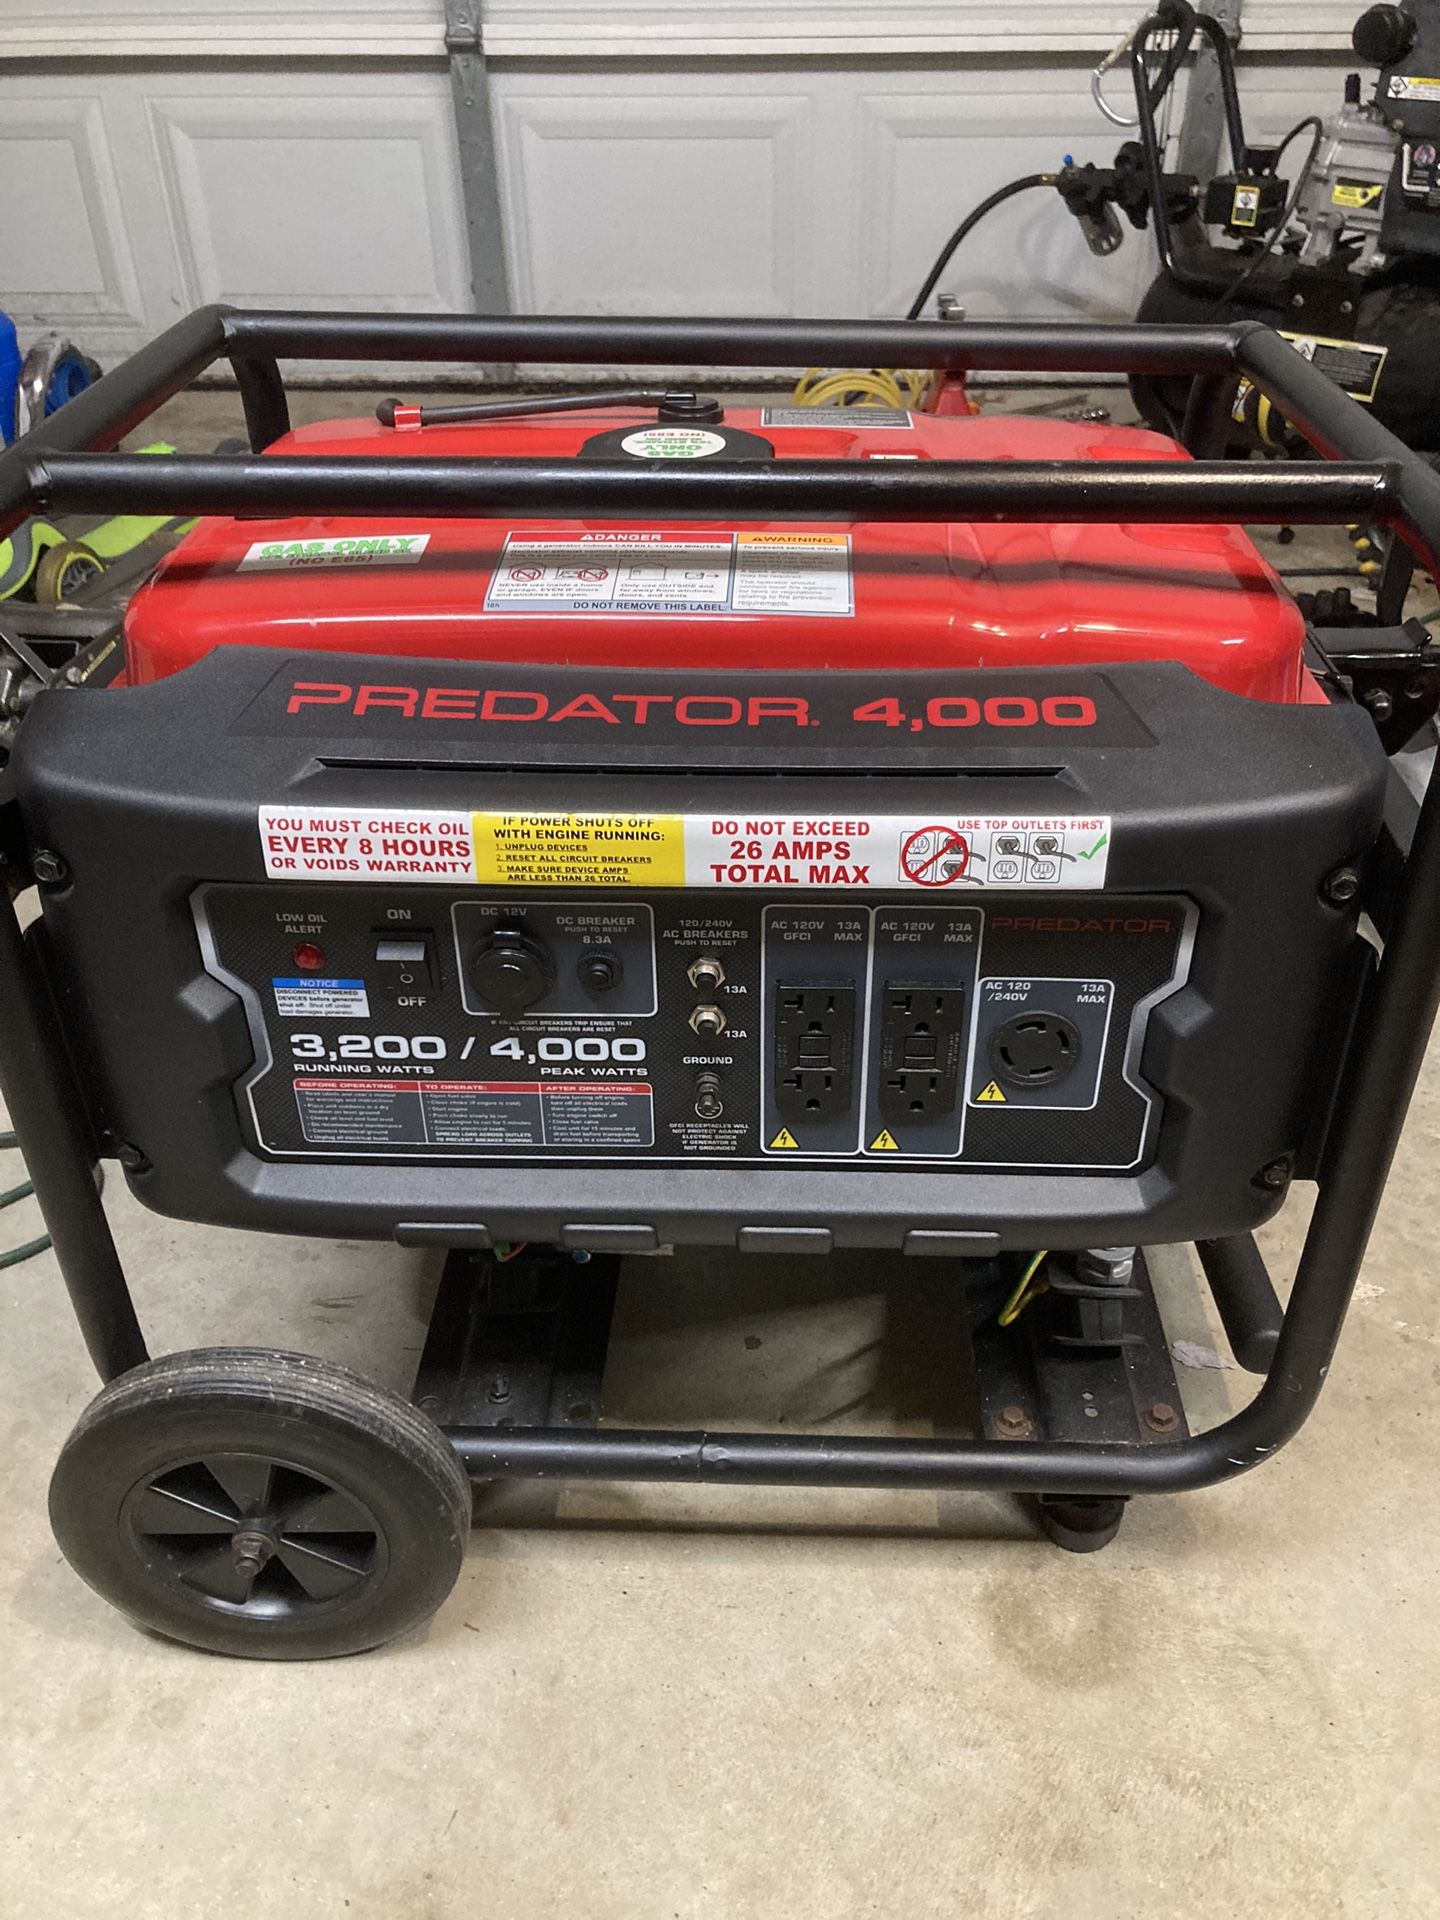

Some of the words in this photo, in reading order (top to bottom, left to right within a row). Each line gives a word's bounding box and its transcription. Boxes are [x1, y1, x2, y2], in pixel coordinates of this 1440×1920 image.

[592, 534, 661, 542] DANGER
[261, 542, 325, 557] GAS
[333, 537, 418, 554] ONLY
[289, 557, 325, 567] (NO
[331, 555, 373, 565] E85)
[616, 602, 660, 610] REMOVE
[690, 603, 727, 611] LABEL.
[853, 695, 1097, 731] 4,000
[266, 818, 303, 831] YOU
[309, 820, 362, 833] MUST
[368, 821, 431, 834] CHECK
[438, 823, 469, 835] OIL
[503, 816, 515, 826] IF
[521, 816, 570, 827] POWER
[575, 818, 623, 828] SHUTS
[628, 818, 655, 828] OFF
[957, 820, 980, 830] USE
[984, 820, 1008, 830] TOP
[1012, 820, 1067, 830] OUTLETS
[1070, 820, 1104, 830] FIRST
[712, 821, 738, 835] DO
[746, 821, 786, 835] NOT
[793, 821, 870, 836] EXCEED
[494, 829, 531, 839] WITH
[536, 830, 590, 840] ENGINE
[595, 831, 665, 841] RUNNING:
[267, 836, 348, 854] EVERY
[359, 838, 373, 855] 8
[383, 839, 471, 857] HOURS
[730, 841, 763, 860] 26
[771, 841, 851, 860] AMPS
[560, 855, 599, 863] CIRCUIT
[271, 857, 297, 869] OR
[304, 858, 360, 870] VOIDS
[367, 860, 471, 873] WARRANTY
[599, 875, 631, 883] TOTAL.
[710, 865, 799, 883] TOTAL
[809, 865, 870, 884] MAX
[387, 909, 412, 920] ON
[481, 907, 498, 916] DC
[503, 907, 527, 916] 12V
[276, 913, 304, 922] LOW
[307, 914, 328, 923] OIL
[556, 917, 574, 925] DC
[578, 917, 635, 926] BREAKER
[680, 920, 733, 928] 120/240V
[771, 921, 787, 929] AC
[792, 921, 825, 930] 120V
[837, 921, 861, 930] 13A
[881, 922, 898, 930] AC
[902, 922, 936, 931] 120V
[947, 923, 972, 931] 13A
[285, 925, 323, 934] ALERT
[663, 930, 680, 939] AC
[683, 930, 749, 939] BREAKERS
[583, 936, 612, 944] 8.3A
[783, 932, 811, 941] GFCI
[834, 932, 863, 941] MAX
[893, 934, 921, 942] GFCI
[943, 934, 973, 943] MAX
[300, 979, 339, 988] NOTICE
[985, 982, 1003, 990] AC
[1007, 982, 1031, 991] 120
[1081, 984, 1105, 993] 13A
[724, 986, 748, 994] 13A
[397, 996, 427, 1007] OFF
[987, 993, 1028, 1001] /240V
[1076, 995, 1106, 1003] MAX
[290, 1033, 447, 1062] 3,200
[460, 1036, 476, 1060] /
[490, 1037, 646, 1065] 4,000
[683, 1057, 734, 1065] GROUND
[294, 1063, 372, 1073] RUNNING
[376, 1065, 435, 1074] WATTS
[541, 1067, 585, 1076] PEAK
[591, 1067, 648, 1076] WATTS
